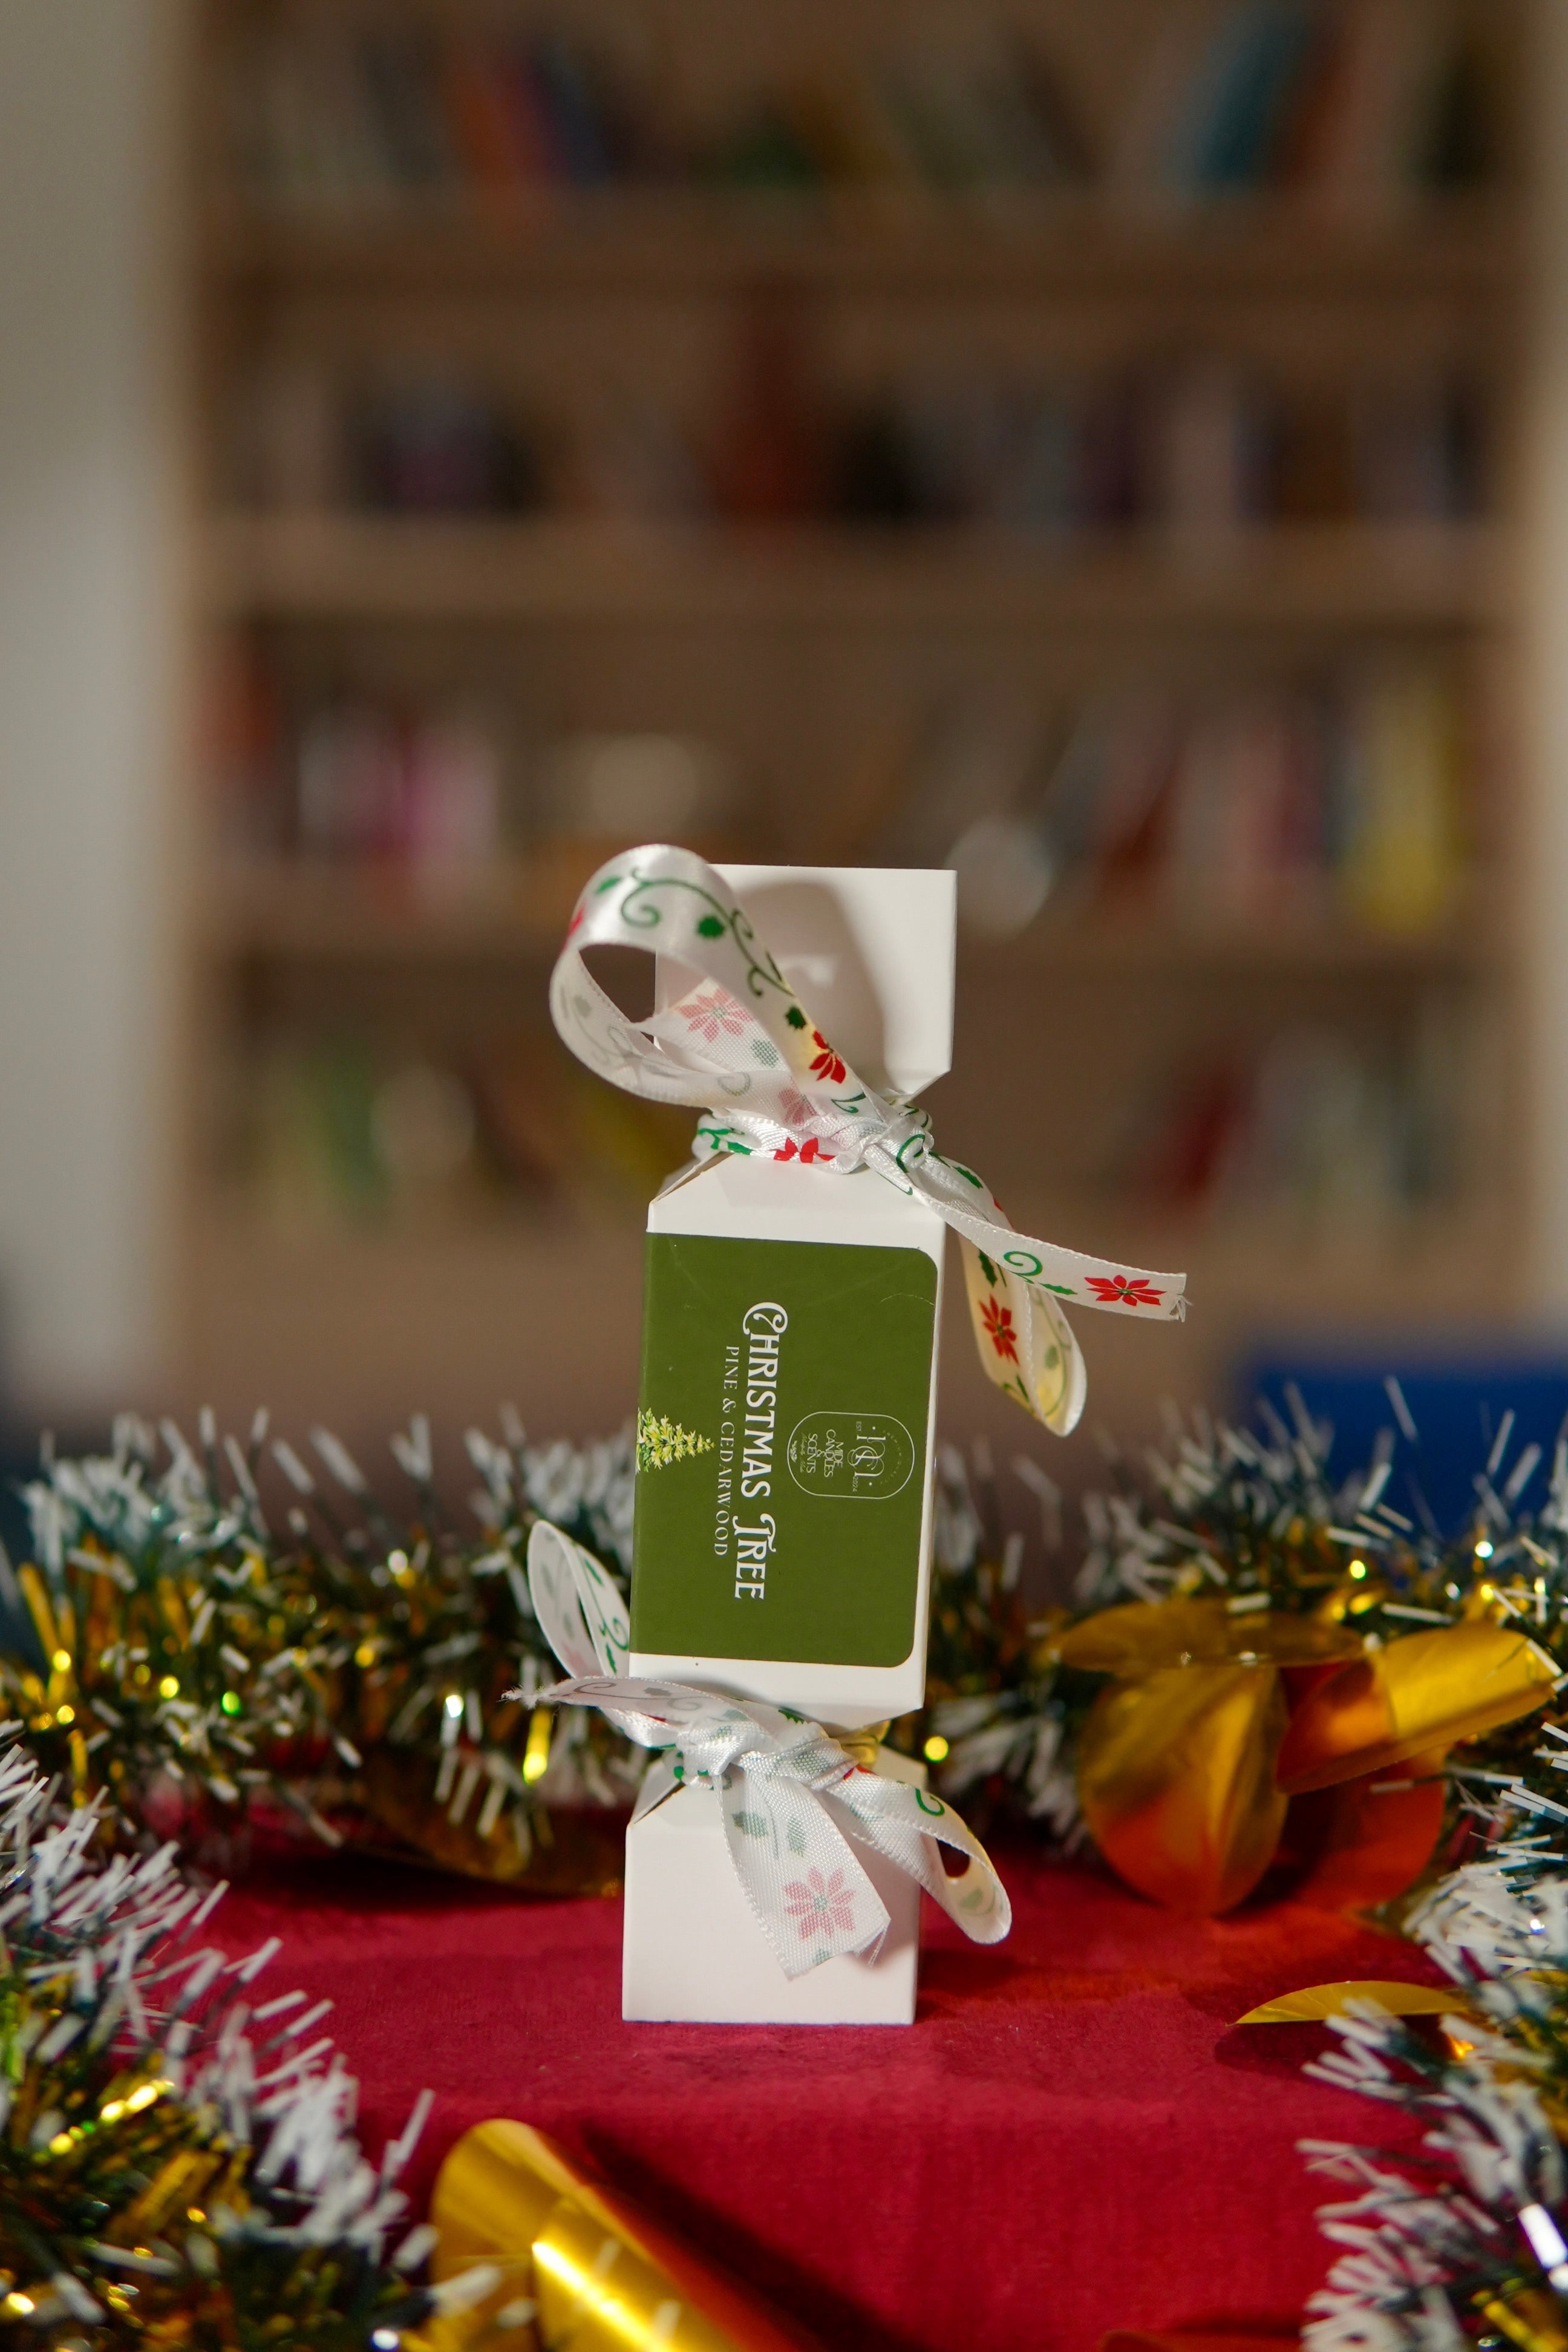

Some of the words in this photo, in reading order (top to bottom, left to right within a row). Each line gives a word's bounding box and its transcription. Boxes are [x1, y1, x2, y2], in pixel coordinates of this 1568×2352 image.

[724, 1346, 740, 1390] PINE
[722, 1397, 736, 1413] &
[741, 1302, 788, 1498] CHRISTMAS
[806, 1433, 818, 1474] SCENTS
[817, 1449, 825, 1457] &
[823, 1429, 837, 1478] CANDLES
[833, 1442, 844, 1468] MIDE
[714, 1422, 734, 1555] CEDARWOOD
[732, 1513, 776, 1600] TREE
